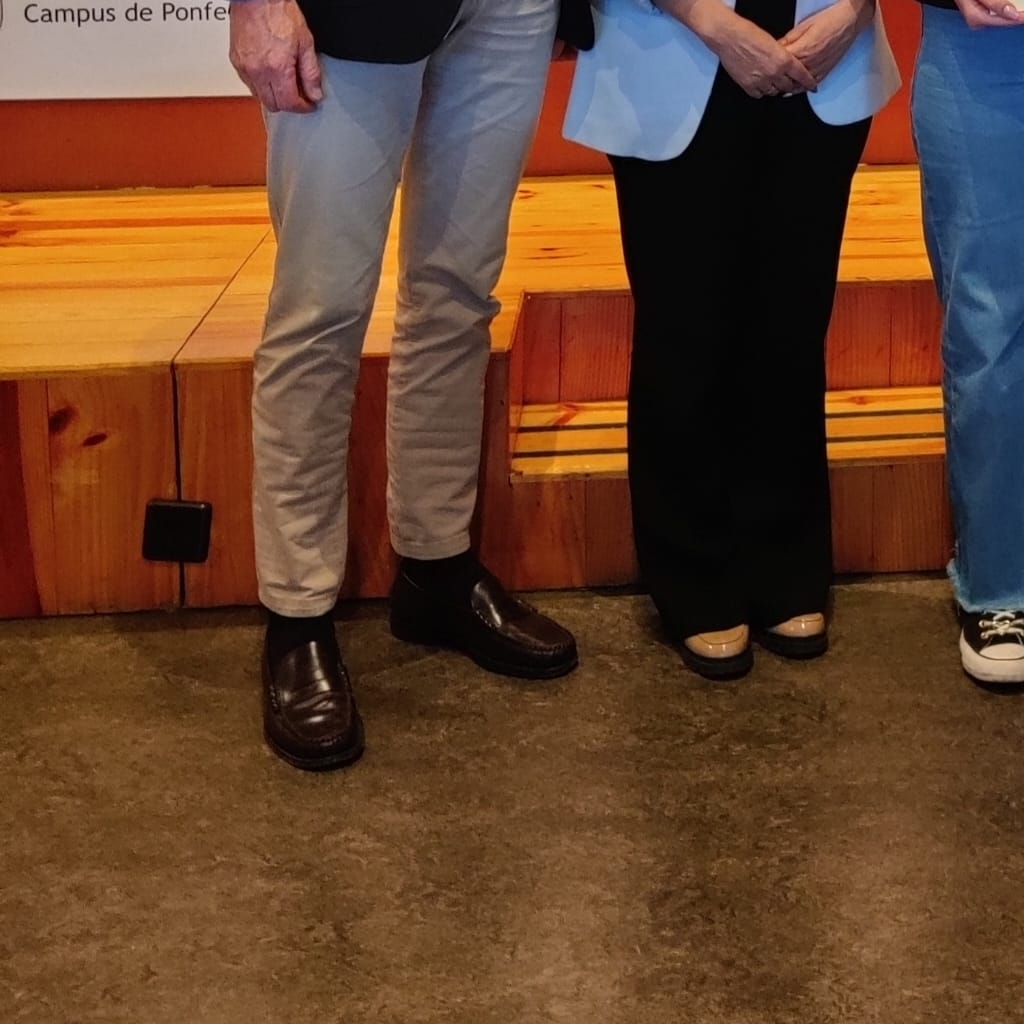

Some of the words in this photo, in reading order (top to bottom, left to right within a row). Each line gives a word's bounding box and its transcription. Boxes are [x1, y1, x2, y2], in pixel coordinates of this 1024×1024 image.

[24, 3, 116, 27] Campus
[125, 3, 153, 22] de
[162, 2, 231, 21] Ponfe
